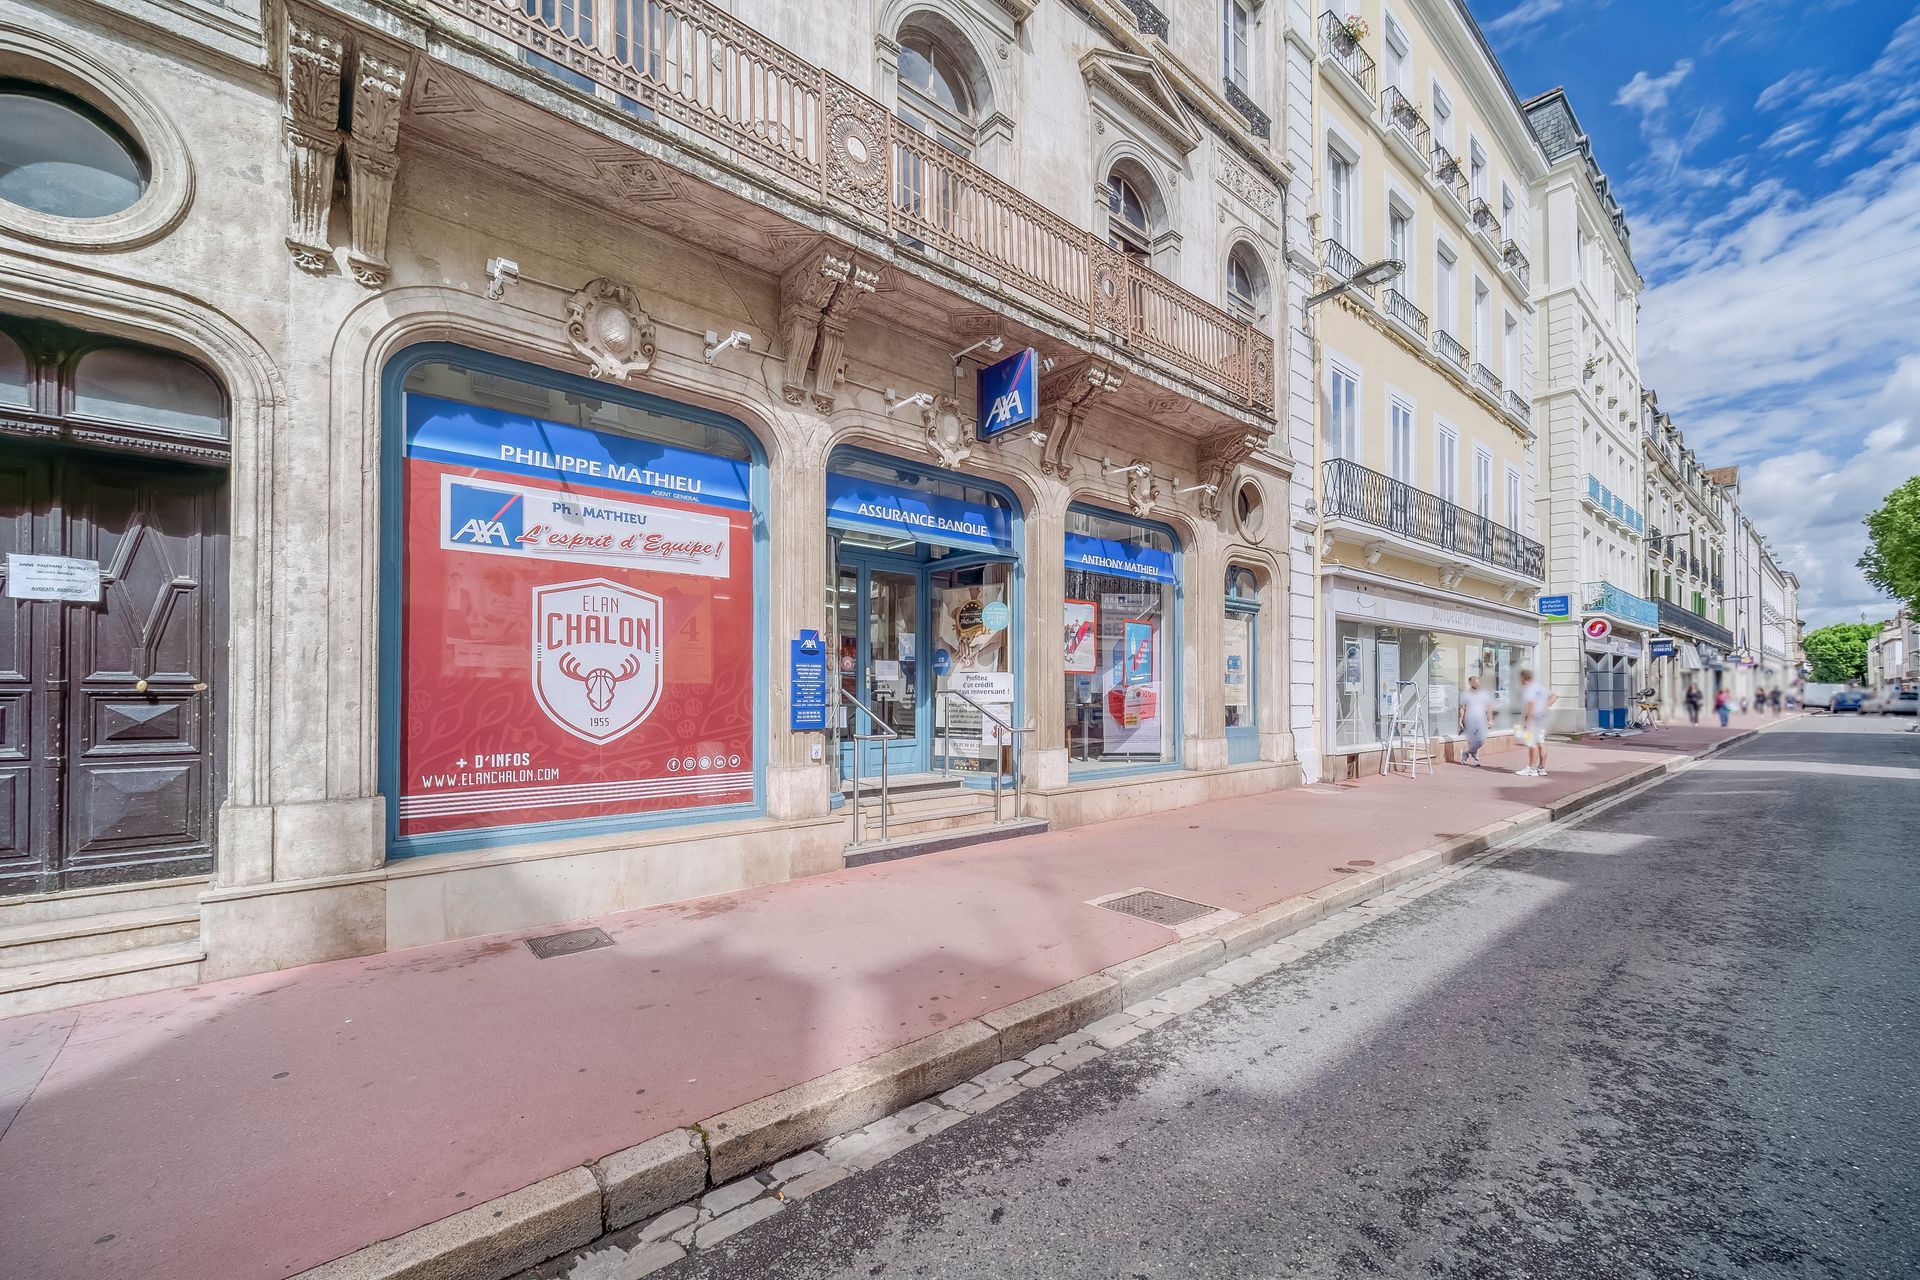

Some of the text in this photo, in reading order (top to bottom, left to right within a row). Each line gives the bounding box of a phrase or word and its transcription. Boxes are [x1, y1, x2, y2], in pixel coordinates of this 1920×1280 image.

[985, 390, 1023, 428] AXA
[500, 444, 702, 494] PHILIPPE MATHIEU
[651, 489, 671, 499] AGENT
[583, 506, 647, 526] MATHIEU
[857, 502, 988, 537] ASSURANCE BANQUE
[451, 518, 511, 546] AXA
[515, 524, 613, 549] L'esprit
[1081, 554, 1159, 576] ANTHONY MATHIEU
[583, 594, 619, 614] ELAN
[546, 611, 651, 655] CHALON
[800, 639, 817, 648] AXA
[966, 674, 988, 682] Profitez
[590, 717, 610, 728] 1955
[475, 752, 531, 769] D'INFOS
[422, 768, 560, 789] WWW.ELANCHALON.COM
